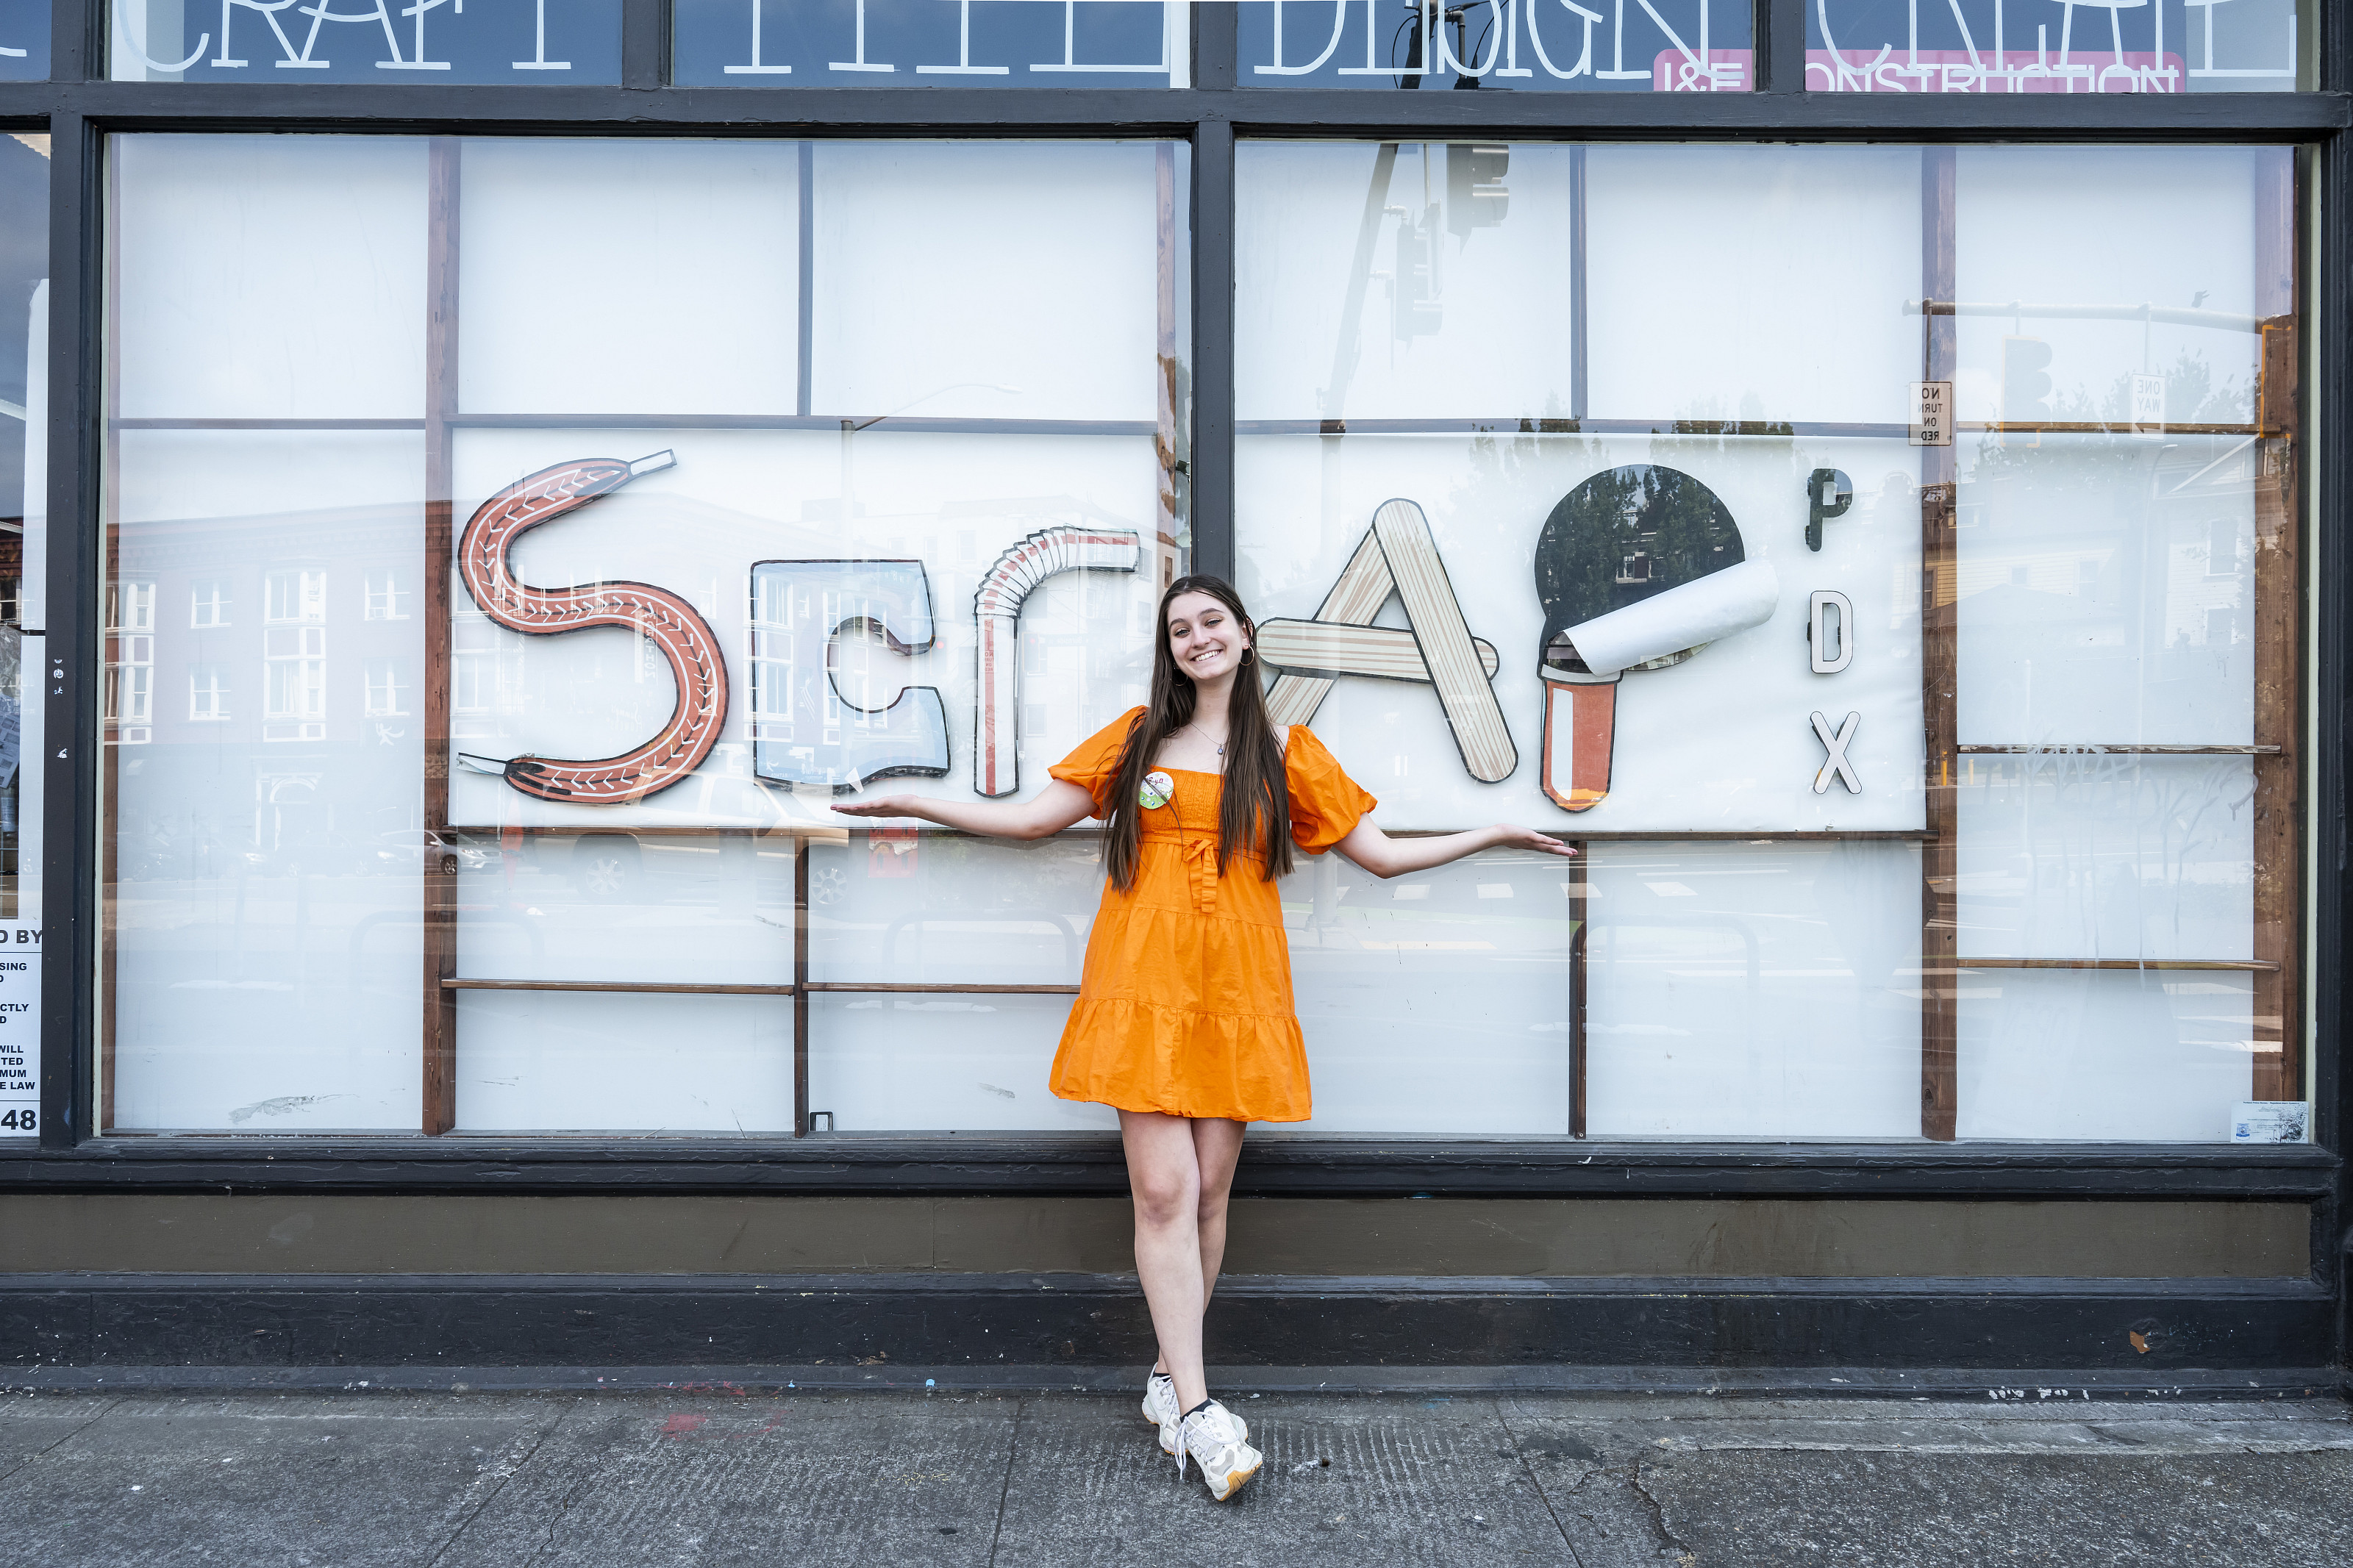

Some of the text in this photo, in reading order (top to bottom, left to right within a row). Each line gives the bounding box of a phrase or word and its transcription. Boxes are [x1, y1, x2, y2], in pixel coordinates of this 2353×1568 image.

[16, 930, 43, 944] BY
[10, 1081, 36, 1090] LAW
[1, 1109, 37, 1131] 48
